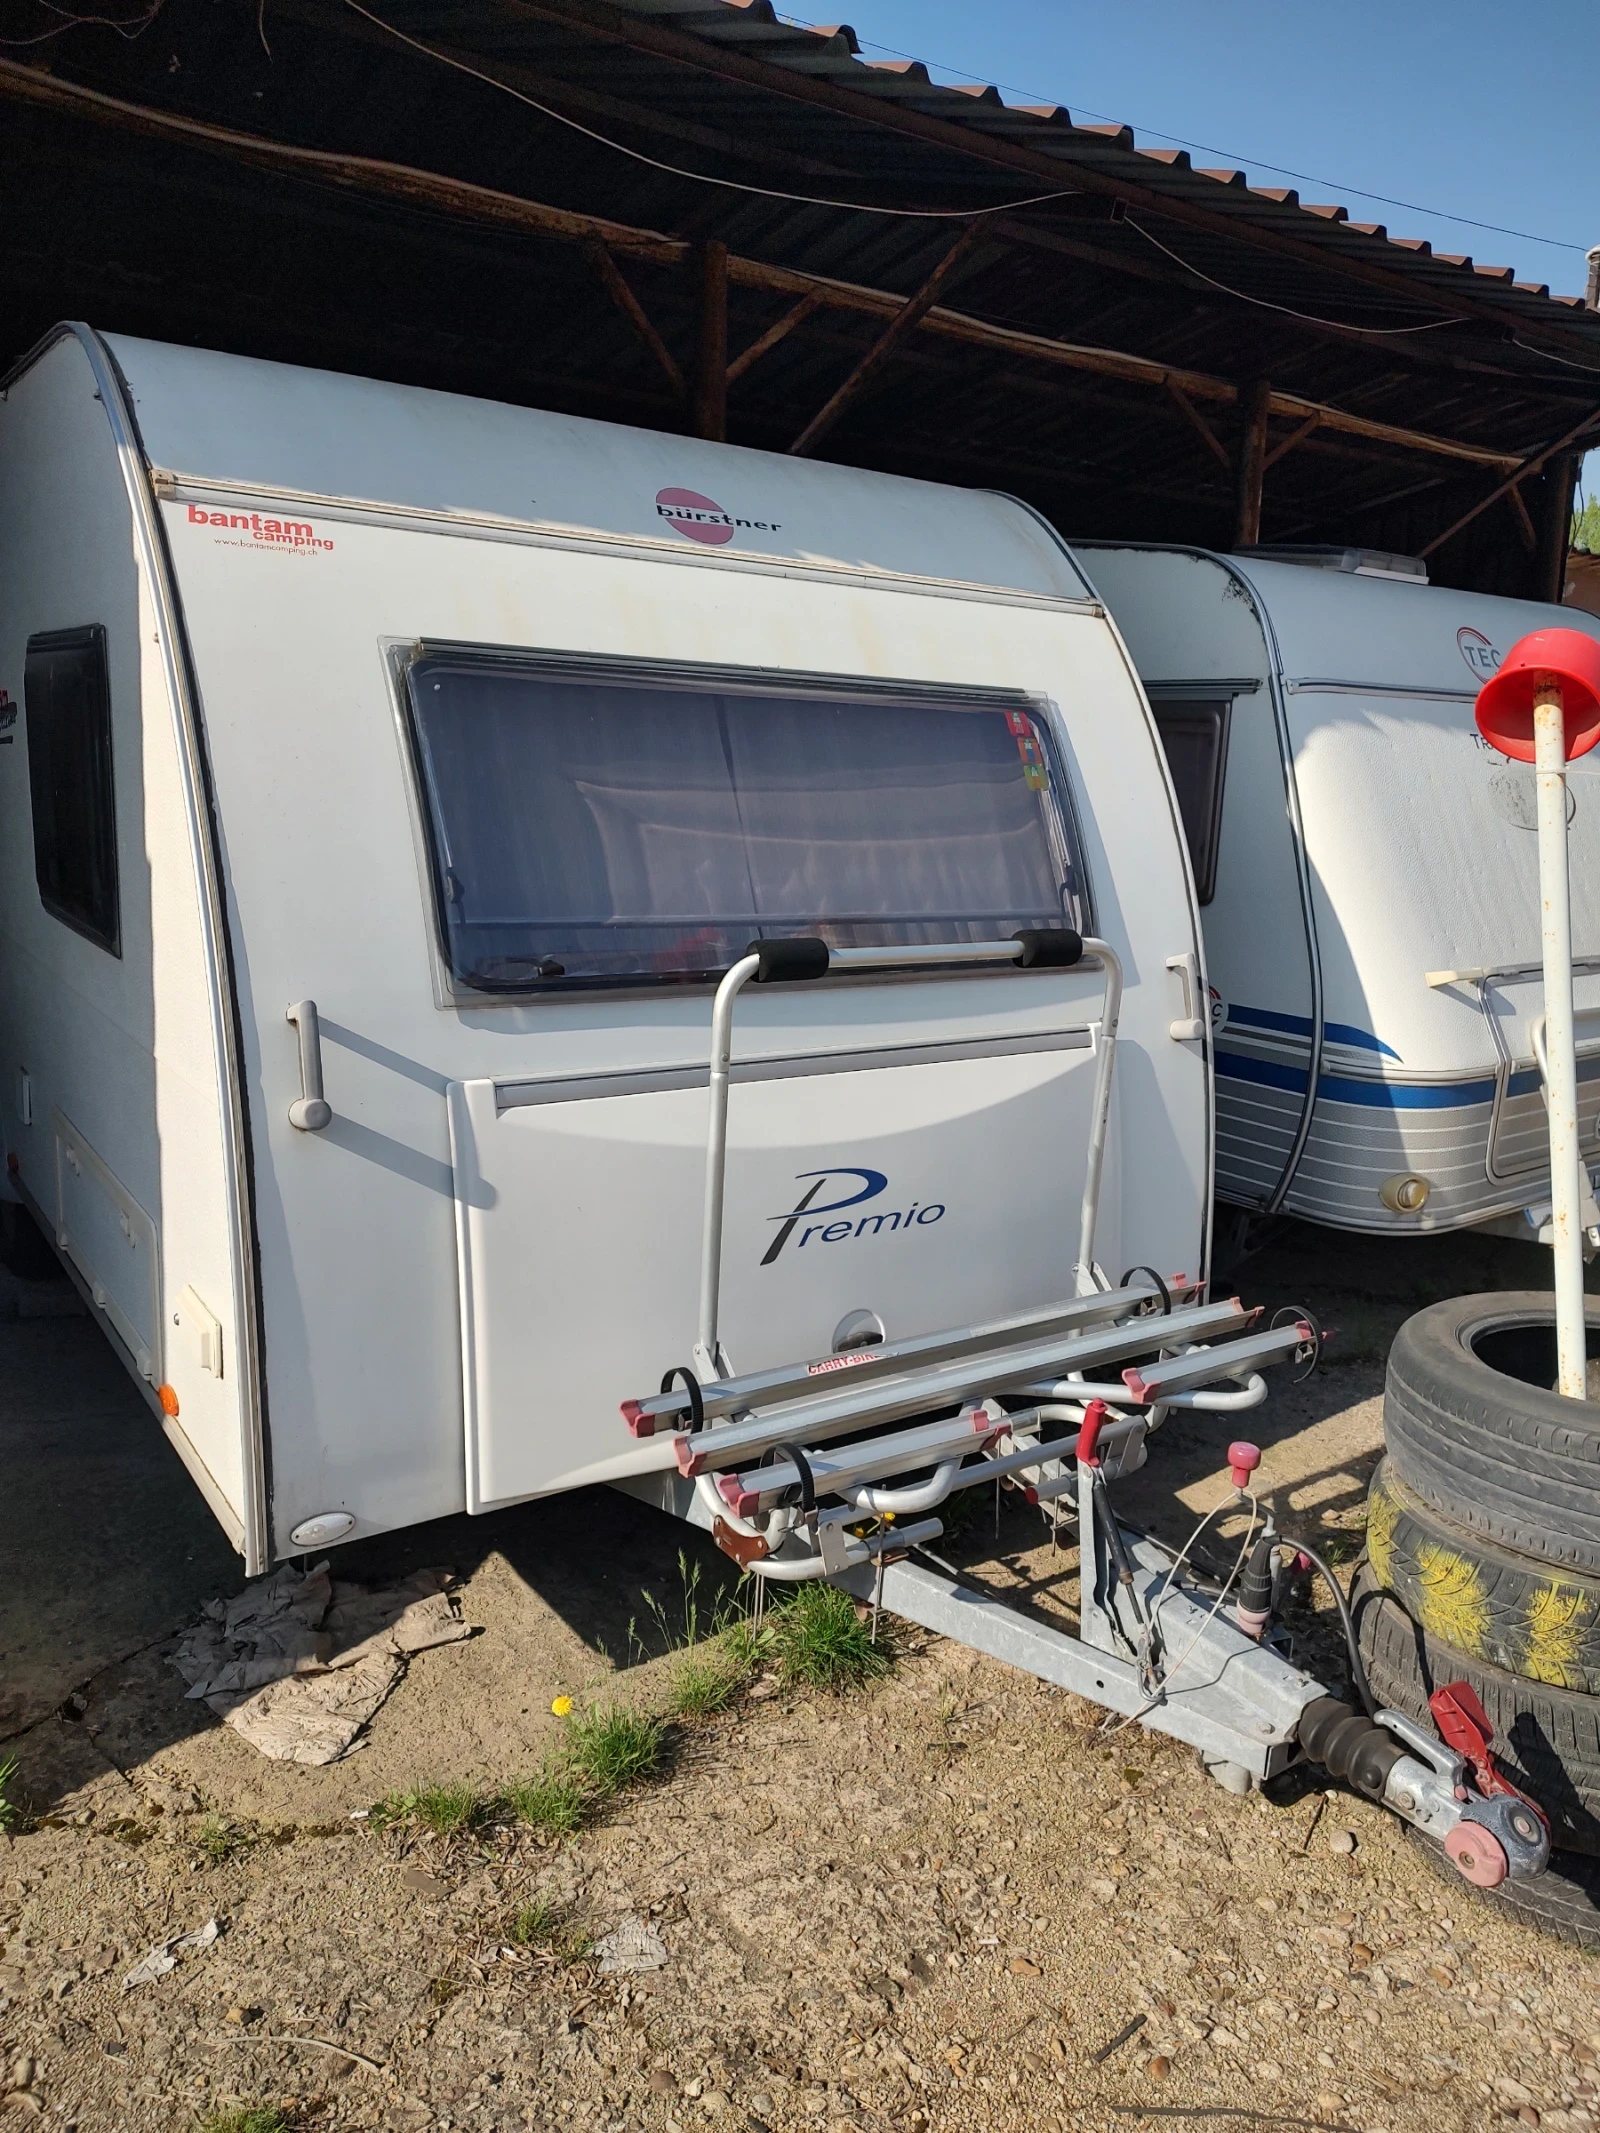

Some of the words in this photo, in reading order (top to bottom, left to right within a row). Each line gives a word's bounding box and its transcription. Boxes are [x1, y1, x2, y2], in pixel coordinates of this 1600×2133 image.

[188, 504, 313, 537] bantam
[656, 505, 782, 532] bürstner
[214, 538, 318, 556] www.bantamcamping.ch
[252, 530, 334, 551] camping
[760, 1168, 946, 1266] Premio
